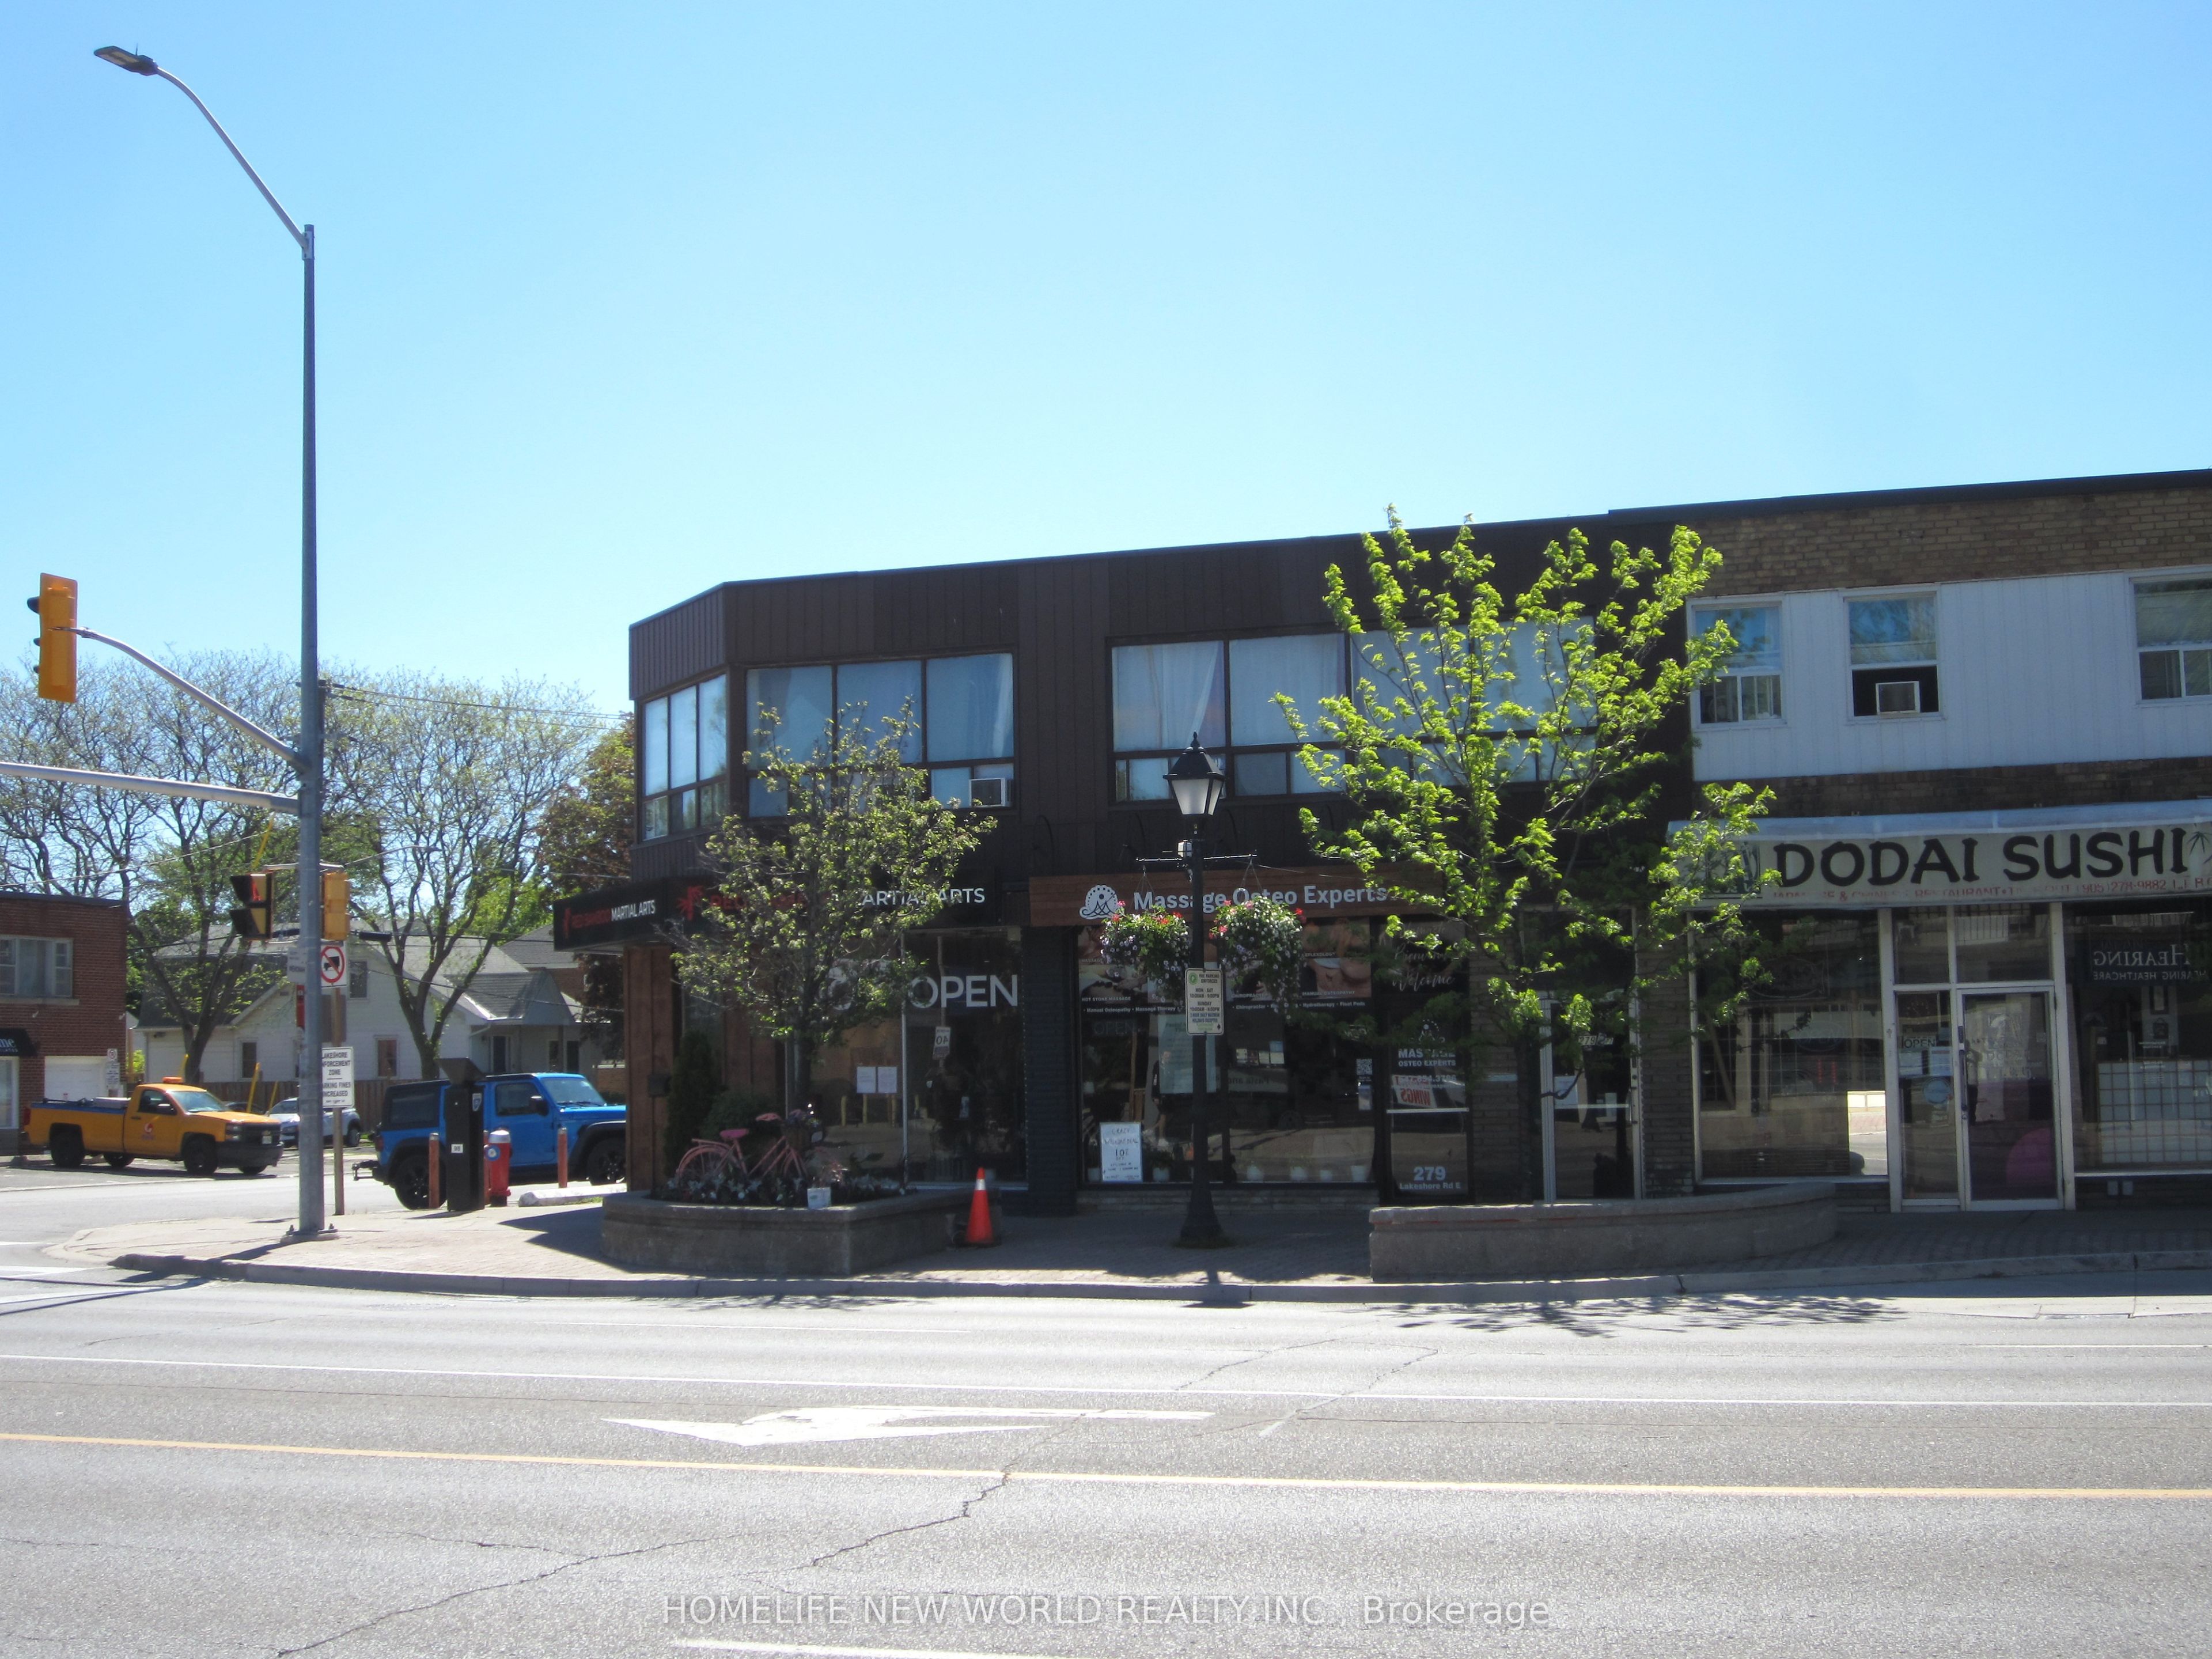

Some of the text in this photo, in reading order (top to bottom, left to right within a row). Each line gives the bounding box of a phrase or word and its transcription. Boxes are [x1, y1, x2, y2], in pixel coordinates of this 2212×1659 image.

[1773, 828, 2188, 887] DODAI SUSHI
[862, 888, 985, 906] ARTIAL ARTS
[1304, 885, 1388, 908] Experts
[611, 904, 638, 921] MARTIAL
[638, 900, 656, 916] ARTS
[909, 974, 1018, 1009] OPEN
[1398, 1048, 1456, 1058] MASAGE
[1904, 1039, 1935, 1048] OPEN
[1414, 1166, 1446, 1181] 279
